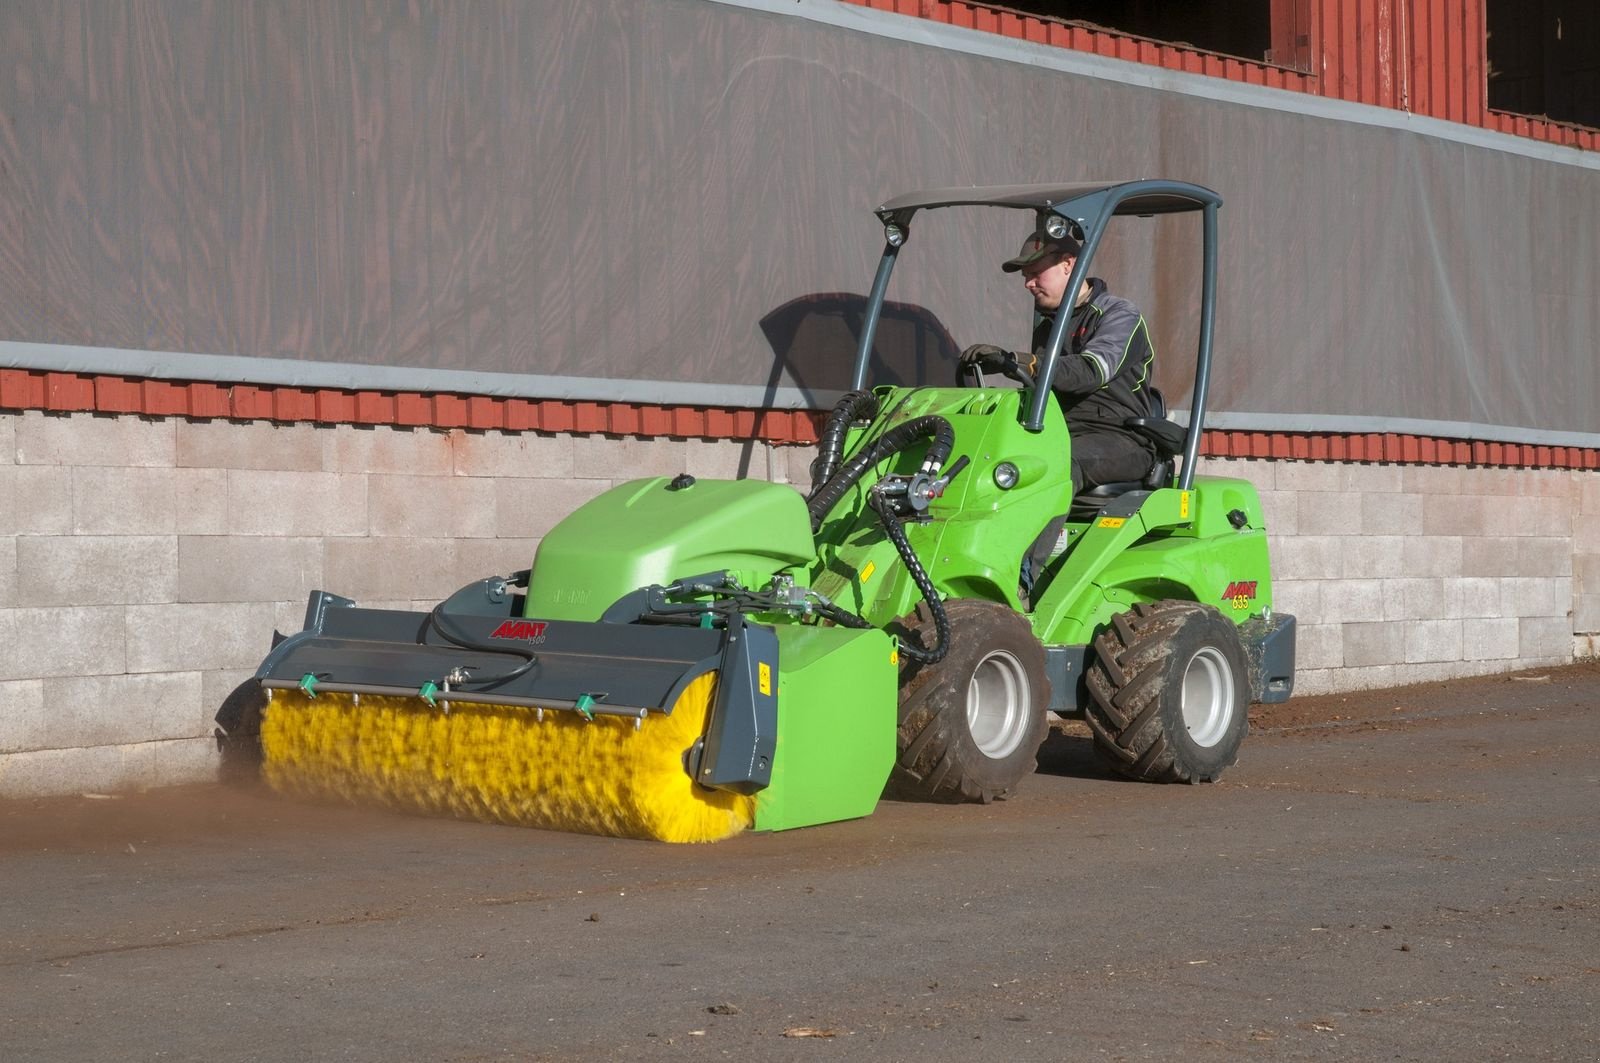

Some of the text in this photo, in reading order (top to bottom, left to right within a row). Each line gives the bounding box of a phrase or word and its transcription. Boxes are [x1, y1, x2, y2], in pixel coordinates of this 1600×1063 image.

[1221, 581, 1257, 600] AVANT
[1232, 594, 1248, 609] 635
[488, 620, 549, 640] AVANT
[528, 634, 546, 646] 1500
